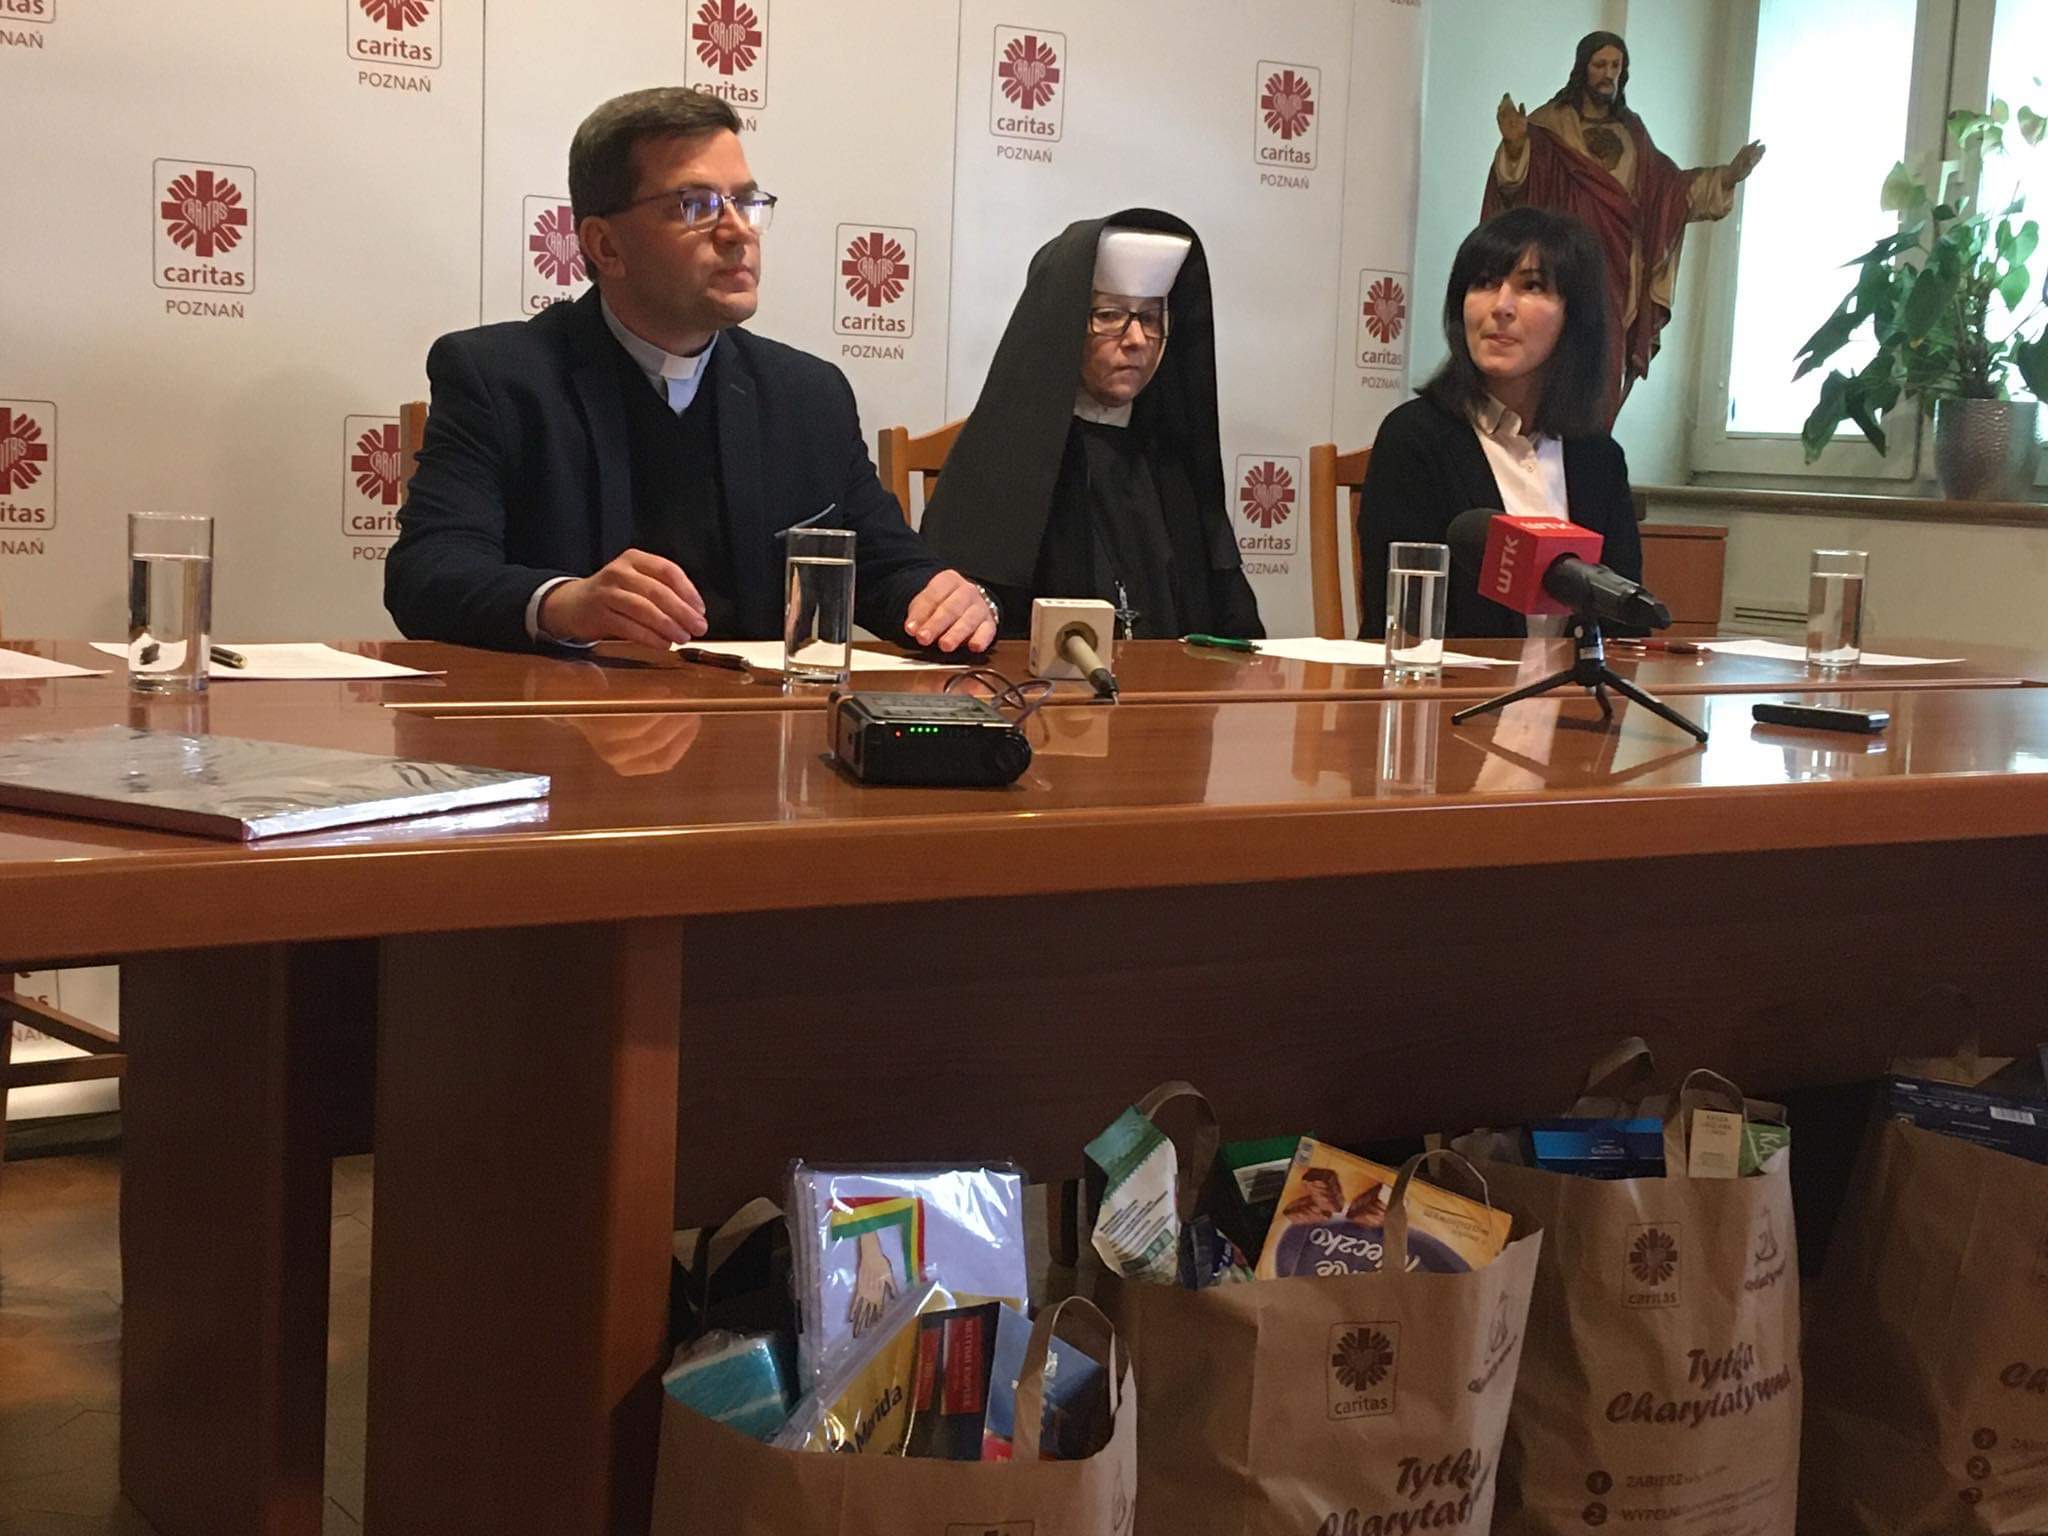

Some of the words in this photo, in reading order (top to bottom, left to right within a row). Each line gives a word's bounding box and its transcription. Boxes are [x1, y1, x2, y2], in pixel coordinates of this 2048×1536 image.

[357, 37, 432, 61] caritas
[359, 71, 431, 92] POZNAŃ
[997, 115, 1055, 136] caritas
[997, 145, 1052, 162] POZNAŃ
[1261, 145, 1311, 164] caritas
[1261, 173, 1309, 189] POZNAŃ
[164, 264, 245, 286] caritas
[166, 300, 244, 318] POZNAŃ
[841, 313, 905, 332] caritas
[842, 345, 904, 360] POZNAŃ
[1240, 534, 1291, 550] caritas
[353, 546, 387, 560] POZ
[1243, 561, 1288, 574] OZNAŃ
[1496, 535, 1519, 594] WTK
[1335, 1395, 1388, 1414] caritas
